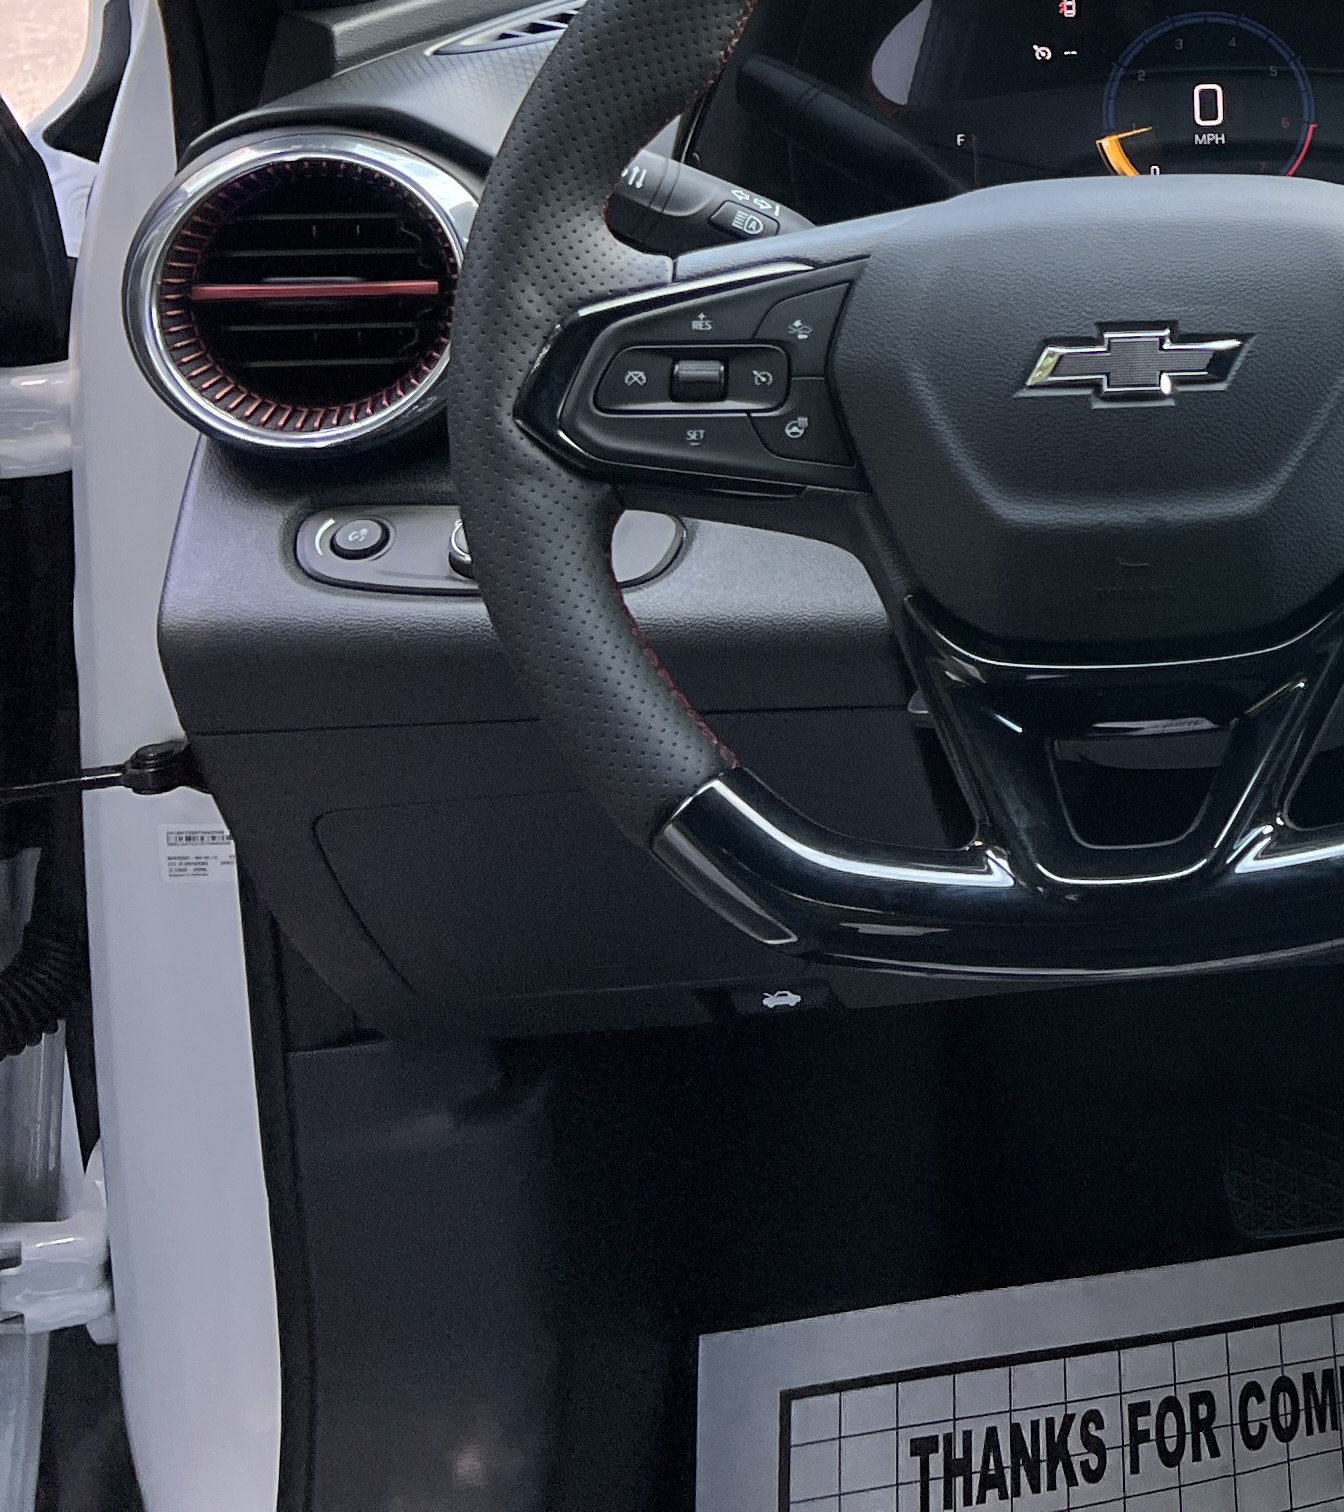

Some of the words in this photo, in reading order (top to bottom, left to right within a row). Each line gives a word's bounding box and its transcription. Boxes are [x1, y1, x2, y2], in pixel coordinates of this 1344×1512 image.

[1175, 39, 1184, 50] 3
[1228, 38, 1237, 48] 4
[1137, 70, 1147, 81] 2
[1269, 66, 1278, 77] 5
[1193, 83, 1224, 126] 0
[1281, 118, 1291, 129] 6
[957, 134, 965, 146] F
[1194, 134, 1225, 145] MPH
[691, 320, 712, 331] RES
[686, 430, 705, 441] SET
[909, 1408, 1108, 1512] THANKS
[1127, 1389, 1220, 1475] FOR
